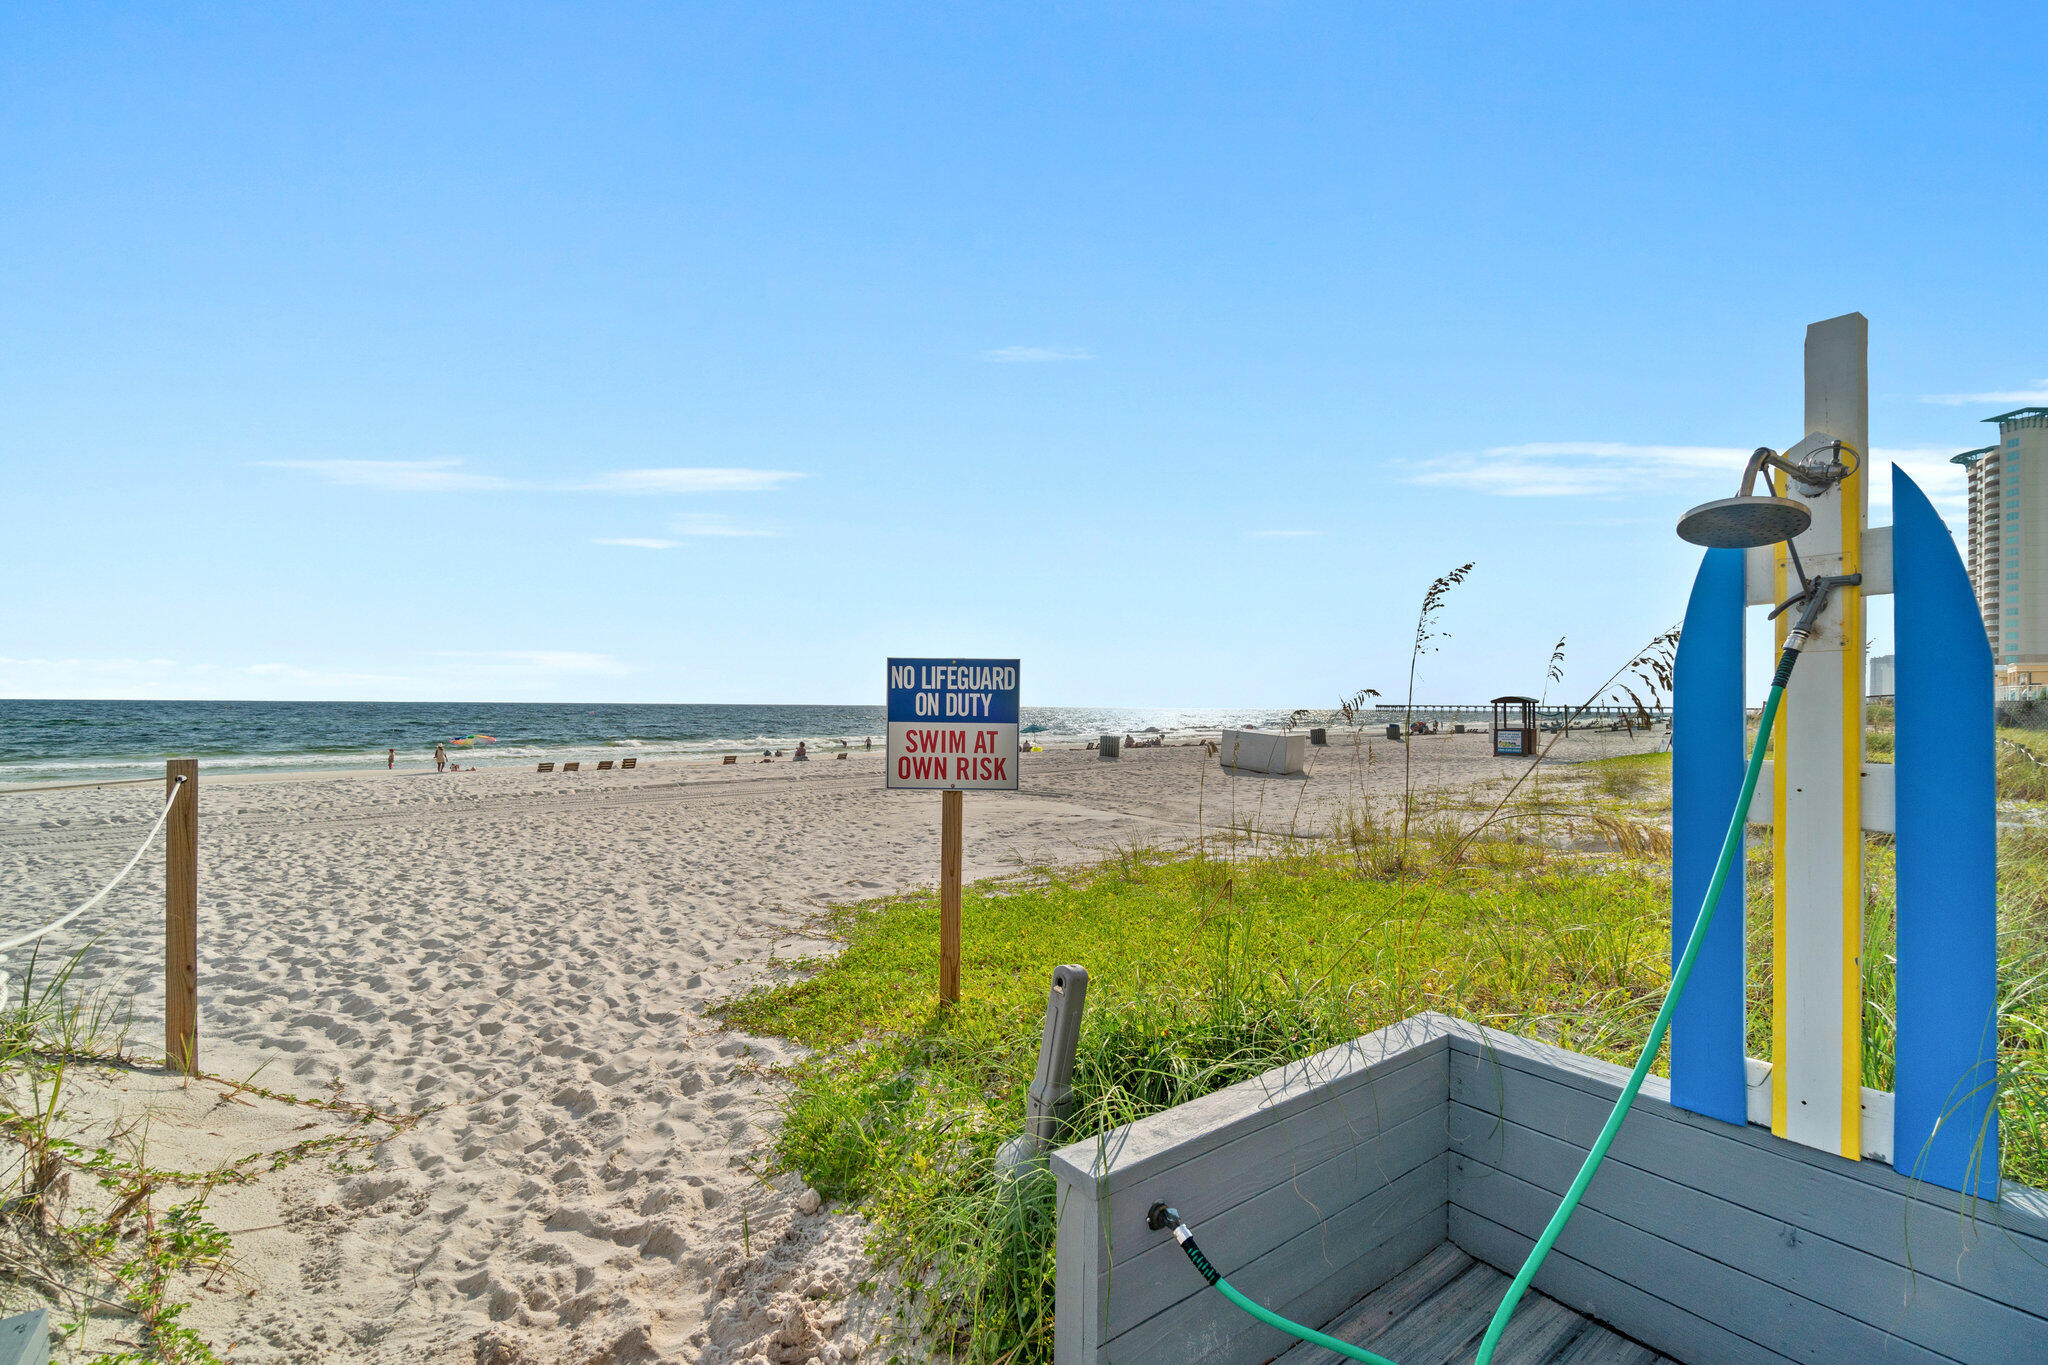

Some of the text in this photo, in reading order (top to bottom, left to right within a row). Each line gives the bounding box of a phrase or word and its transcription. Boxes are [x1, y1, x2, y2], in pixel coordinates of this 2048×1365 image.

[891, 665, 1016, 690] NO LIFEGUARD
[915, 692, 992, 717] ON DUTY
[905, 729, 998, 754] SWIM AT
[898, 756, 1007, 781] OWN RISK
